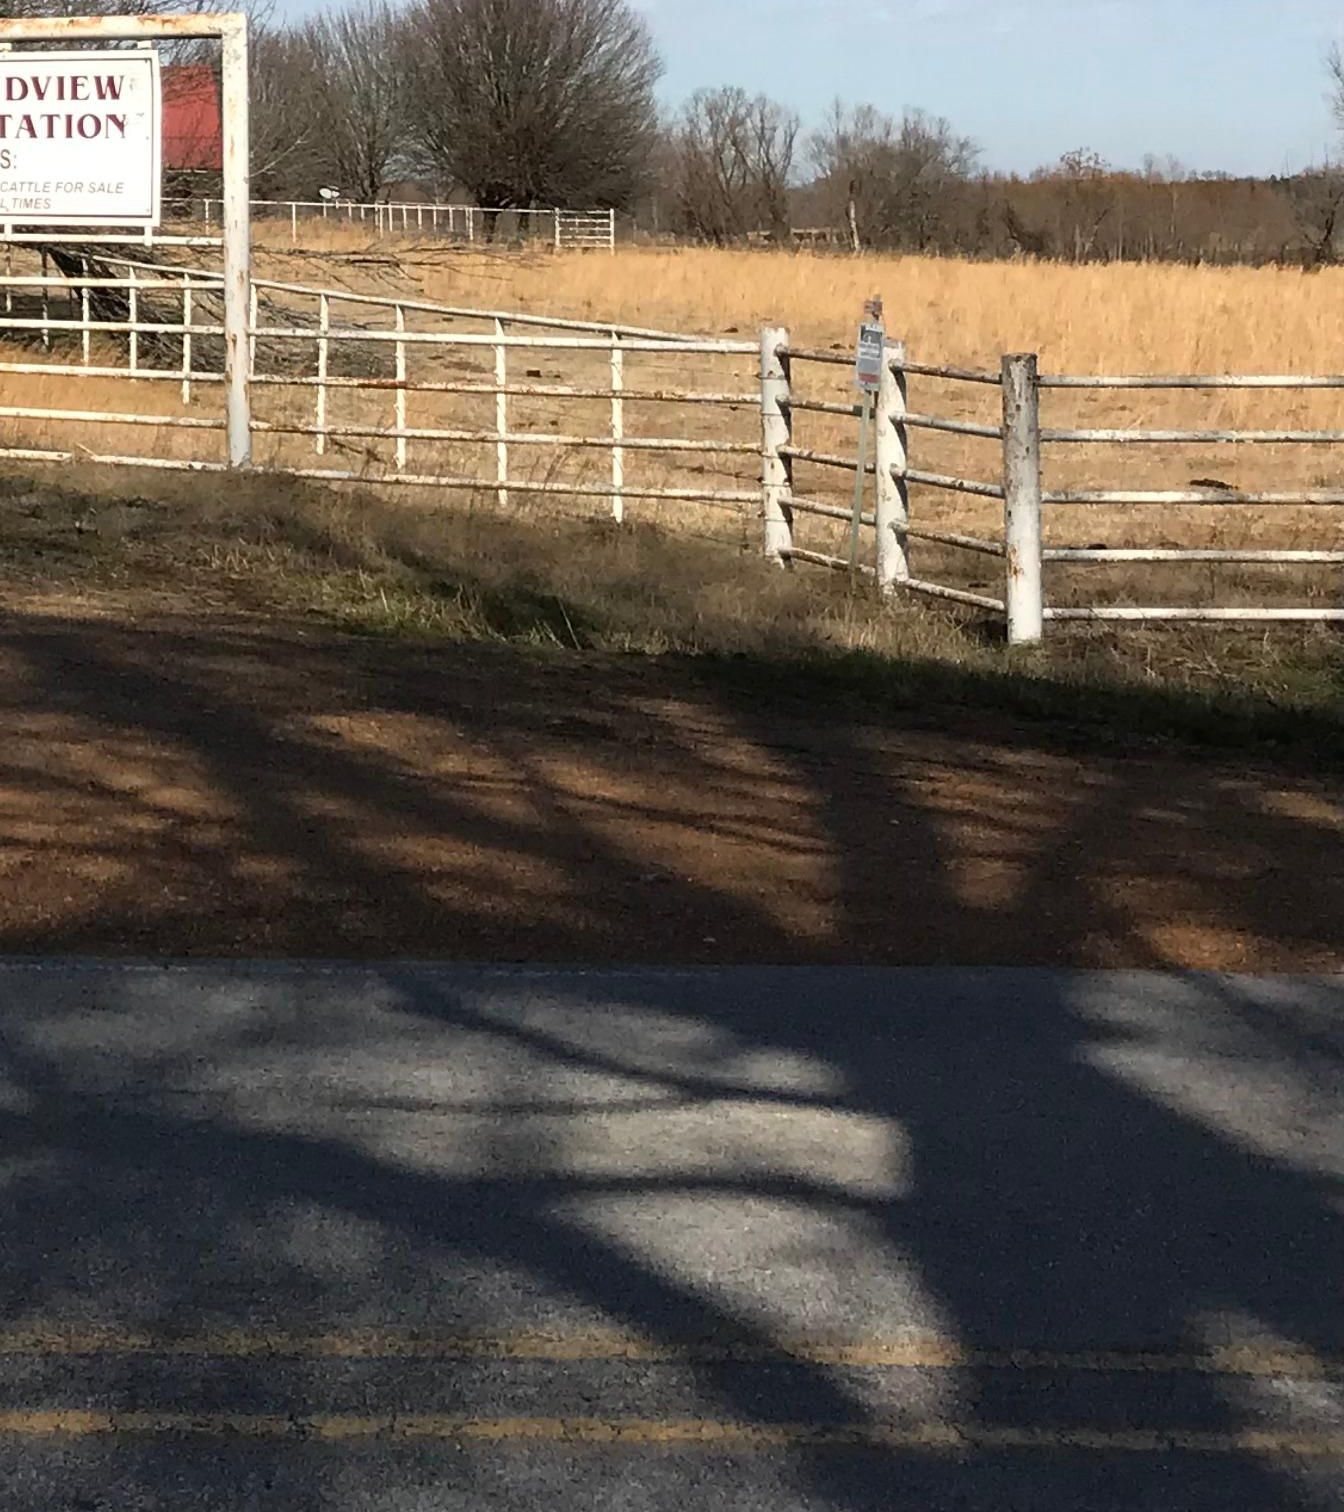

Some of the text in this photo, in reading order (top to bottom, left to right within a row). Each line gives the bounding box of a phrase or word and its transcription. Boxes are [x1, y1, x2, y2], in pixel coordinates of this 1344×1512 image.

[0, 181, 51, 193] CATTLE
[55, 182, 84, 193] FOR
[88, 182, 125, 194] SALE
[12, 198, 51, 209] TIMES
